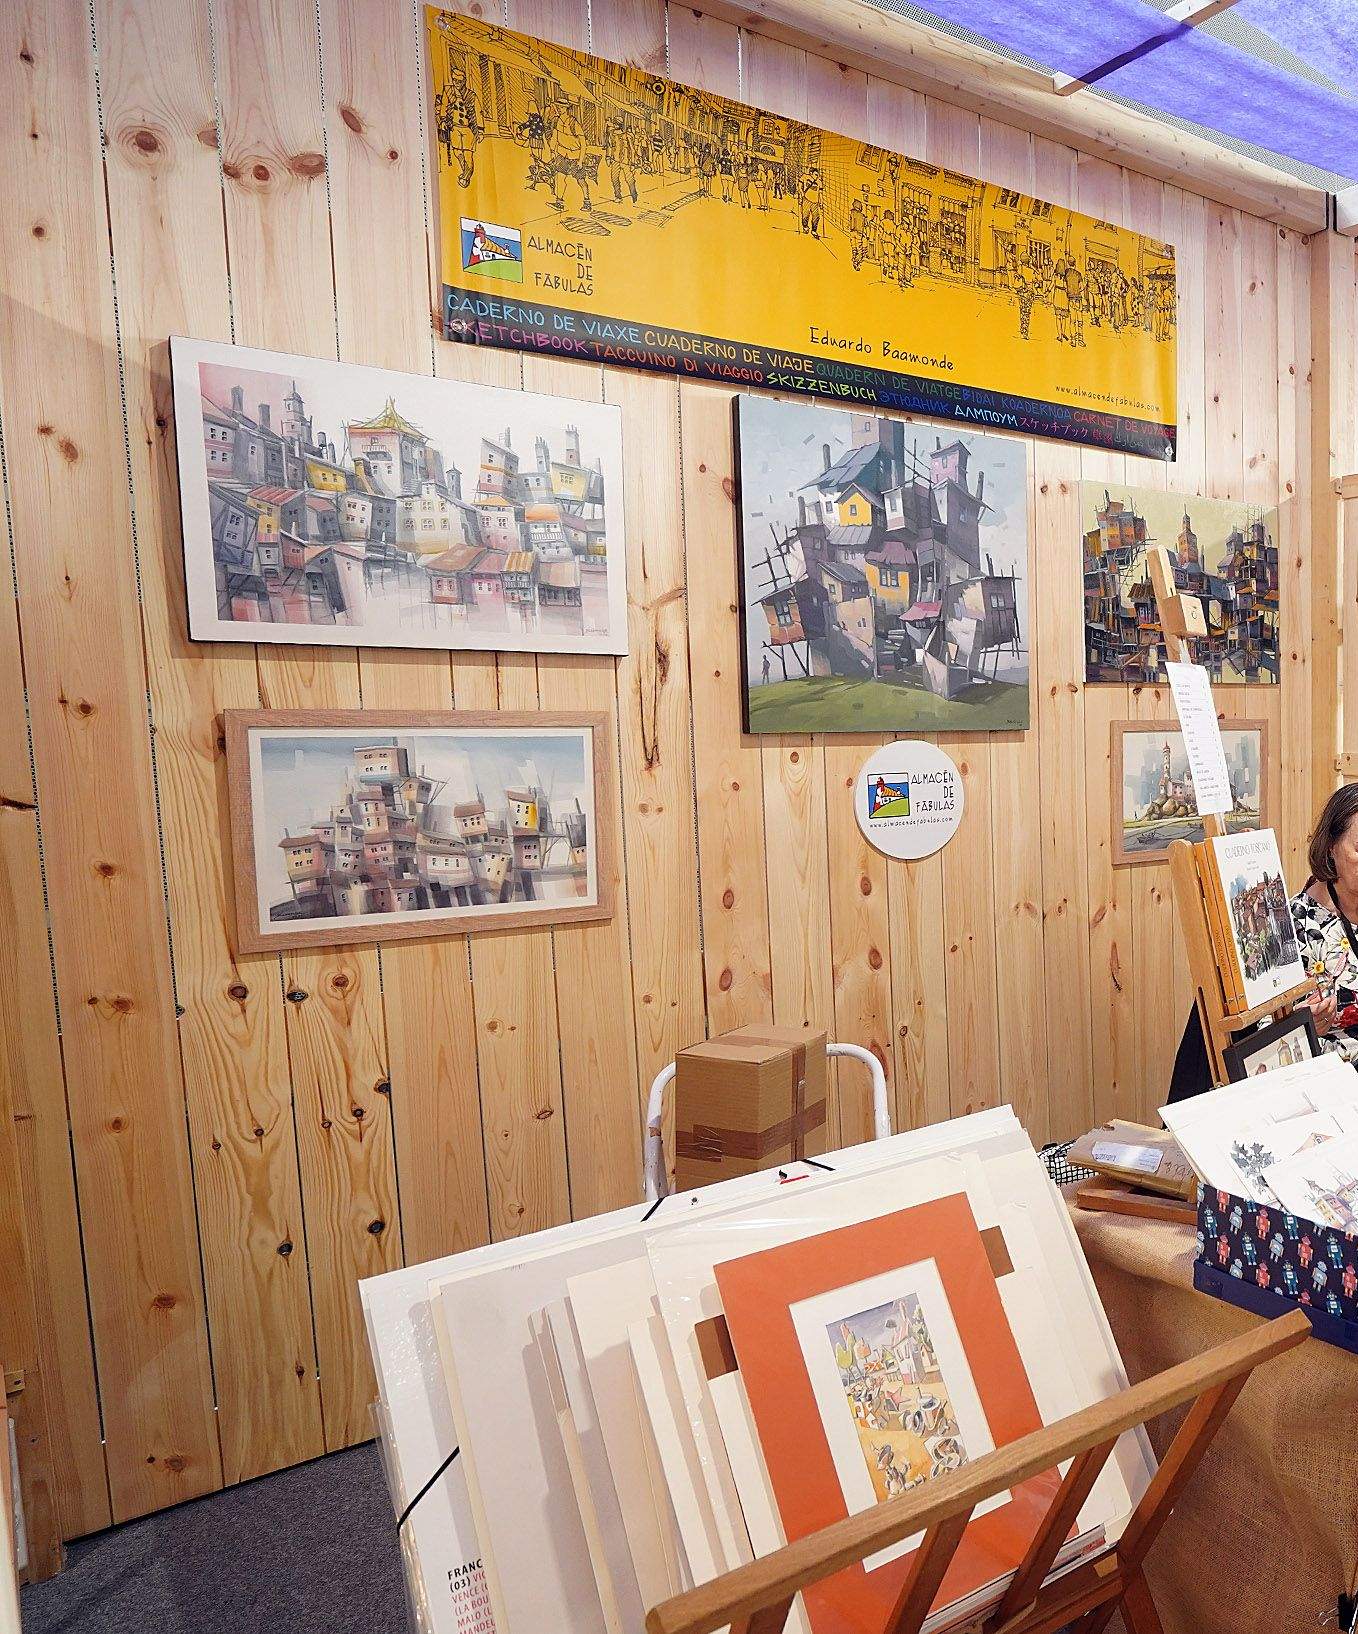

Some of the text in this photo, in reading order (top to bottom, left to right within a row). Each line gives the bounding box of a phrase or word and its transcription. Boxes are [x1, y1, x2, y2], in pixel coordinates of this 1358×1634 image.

[577, 263, 593, 281] DE
[447, 294, 641, 343] CADERNO DE VIAXE
[448, 319, 588, 354] KETCHBOOK
[810, 326, 954, 371] Eduardo Baamonde
[590, 341, 763, 383] TACCUINO DI VIAGGIO
[644, 331, 815, 374] CUADERNO DE VIAJE
[767, 372, 877, 402] SKIZZENBUCH
[816, 363, 961, 400] QUADERN DE VIATGE
[1055, 386, 1161, 412] www.almacendefabulas.com
[1073, 411, 1122, 430] CARNET
[1125, 419, 1138, 433] DE
[943, 785, 954, 798] DE
[447, 1558, 483, 1580] FRANC
[449, 1576, 471, 1593] (03)
[451, 1586, 479, 1604] VENCE
[471, 1595, 490, 1609] BOU
[457, 1611, 481, 1628] MALO
